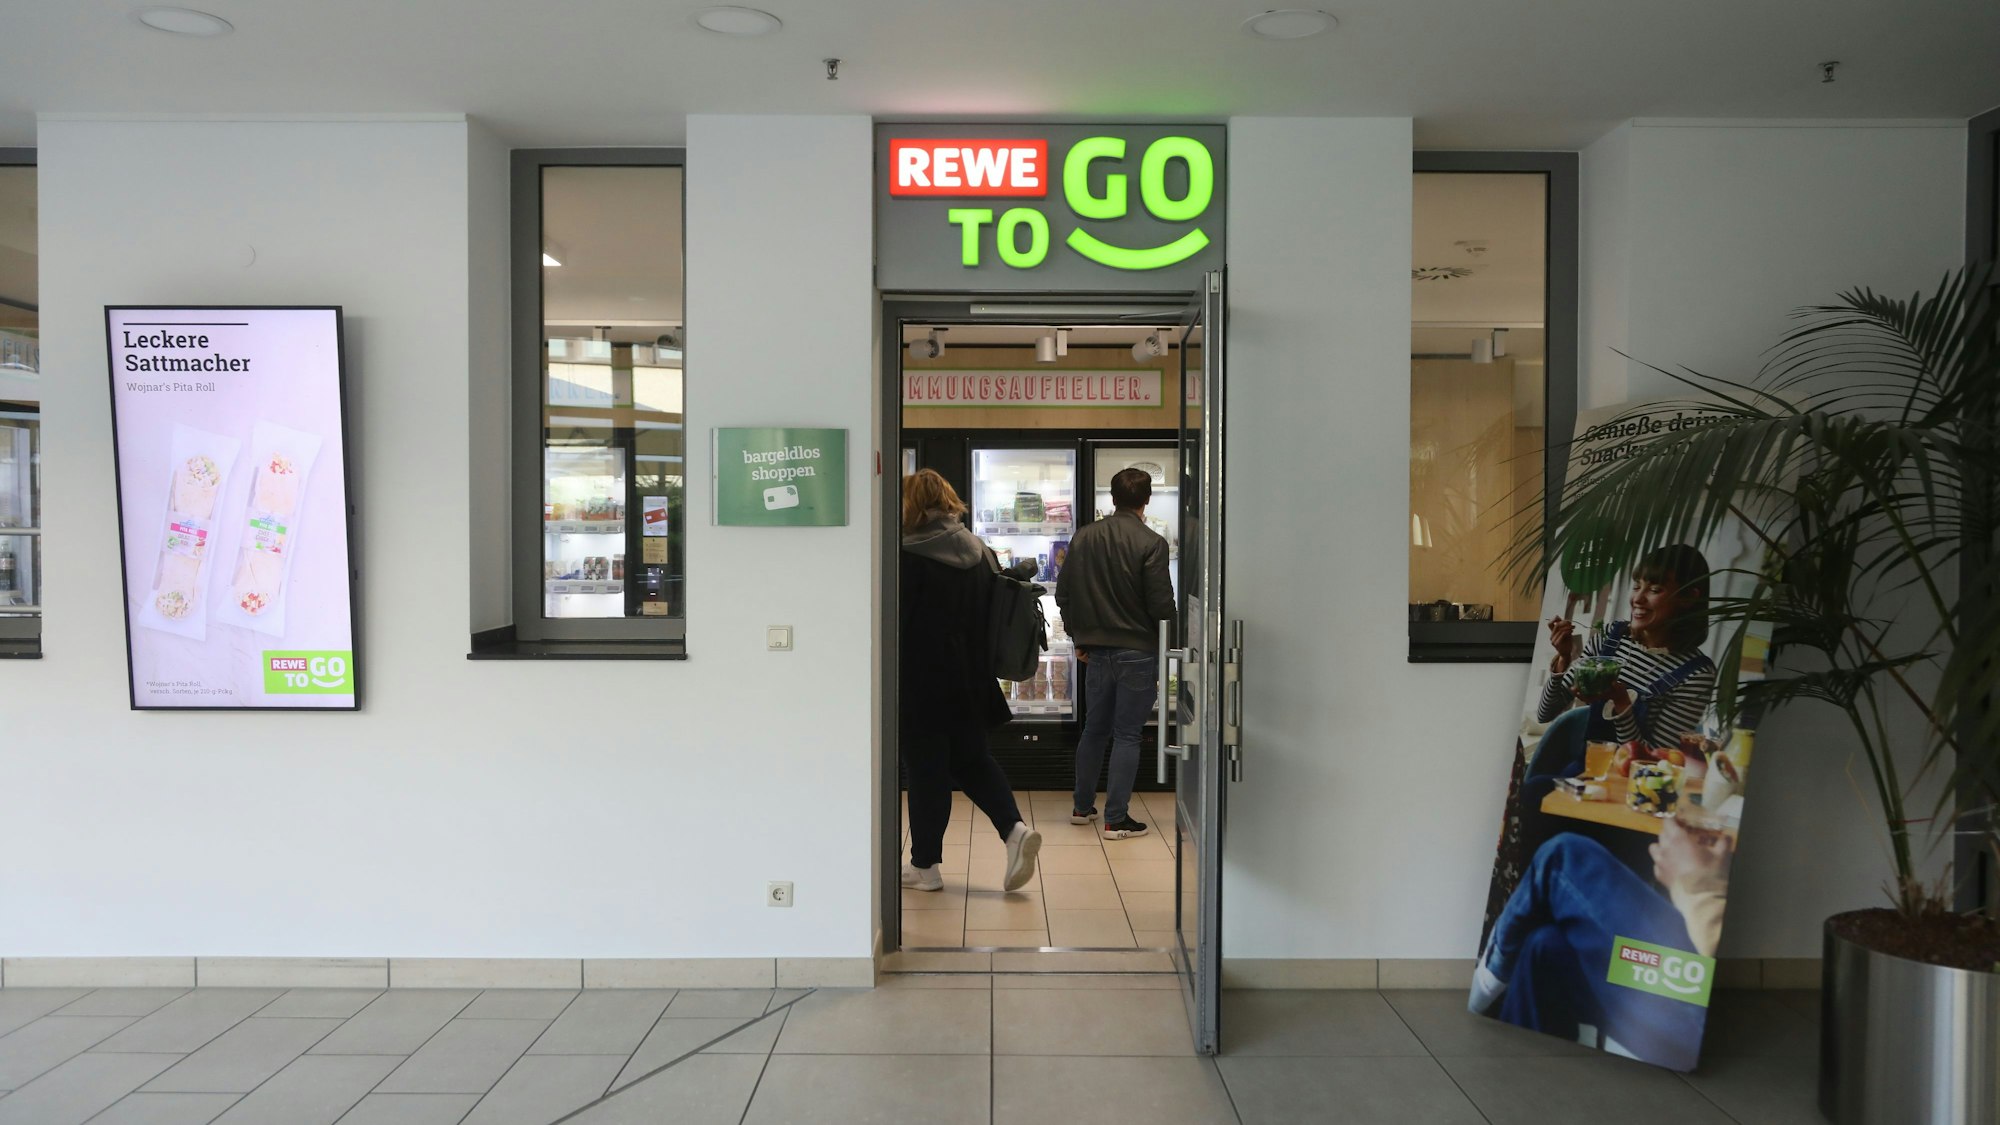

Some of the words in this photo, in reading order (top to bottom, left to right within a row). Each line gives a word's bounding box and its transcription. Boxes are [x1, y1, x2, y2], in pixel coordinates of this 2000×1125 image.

[898, 147, 1040, 188] REWE
[1062, 136, 1215, 222] GO
[948, 207, 1050, 268] TO
[123, 330, 209, 349] Leckere
[125, 353, 251, 372] Sattmacher
[126, 382, 171, 394] Wojnar's
[173, 382, 194, 392] Pita
[196, 382, 215, 392] Roll
[908, 375, 1151, 401] MMUNGSAUFHELLER.
[1584, 416, 1662, 442] Genieße
[741, 446, 821, 465] bargeldlos
[751, 465, 816, 482] shoppen
[272, 659, 307, 670] REWE
[310, 656, 346, 677] GO
[284, 673, 309, 688] TO
[1621, 948, 1659, 966] REWE
[1663, 956, 1705, 984] GO
[1632, 966, 1659, 985] TO
